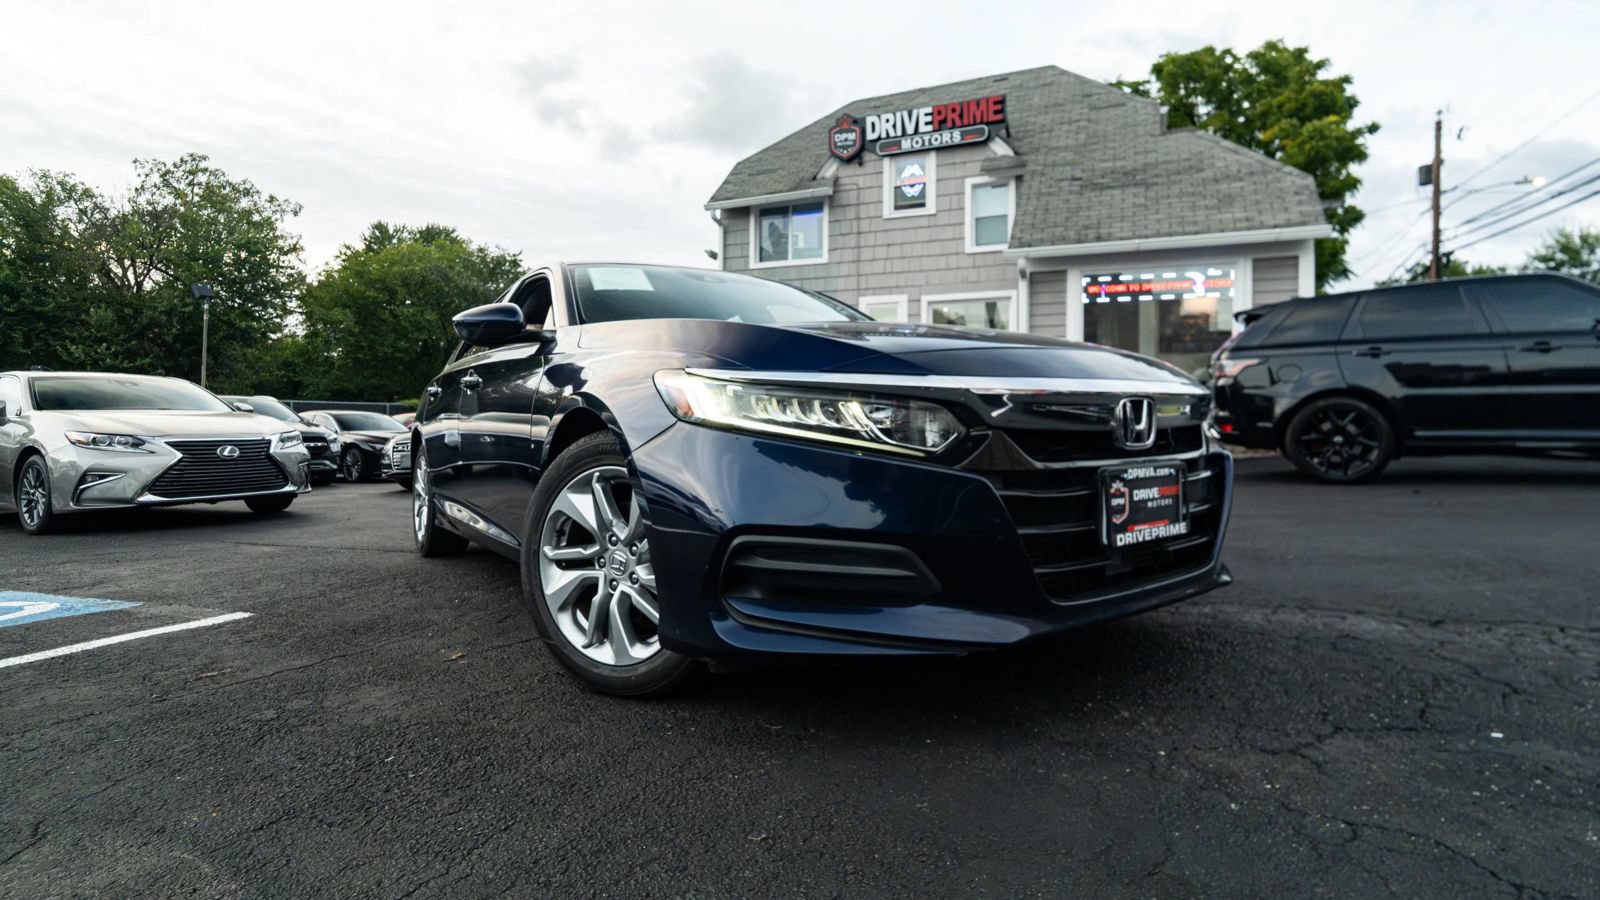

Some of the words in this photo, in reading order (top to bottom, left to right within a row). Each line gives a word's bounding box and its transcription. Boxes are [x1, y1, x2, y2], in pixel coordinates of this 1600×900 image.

[866, 95, 1004, 141] DRIVEPRIME
[901, 131, 961, 149] MOTORS
[1116, 522, 1187, 547] DRIVEPRIME
